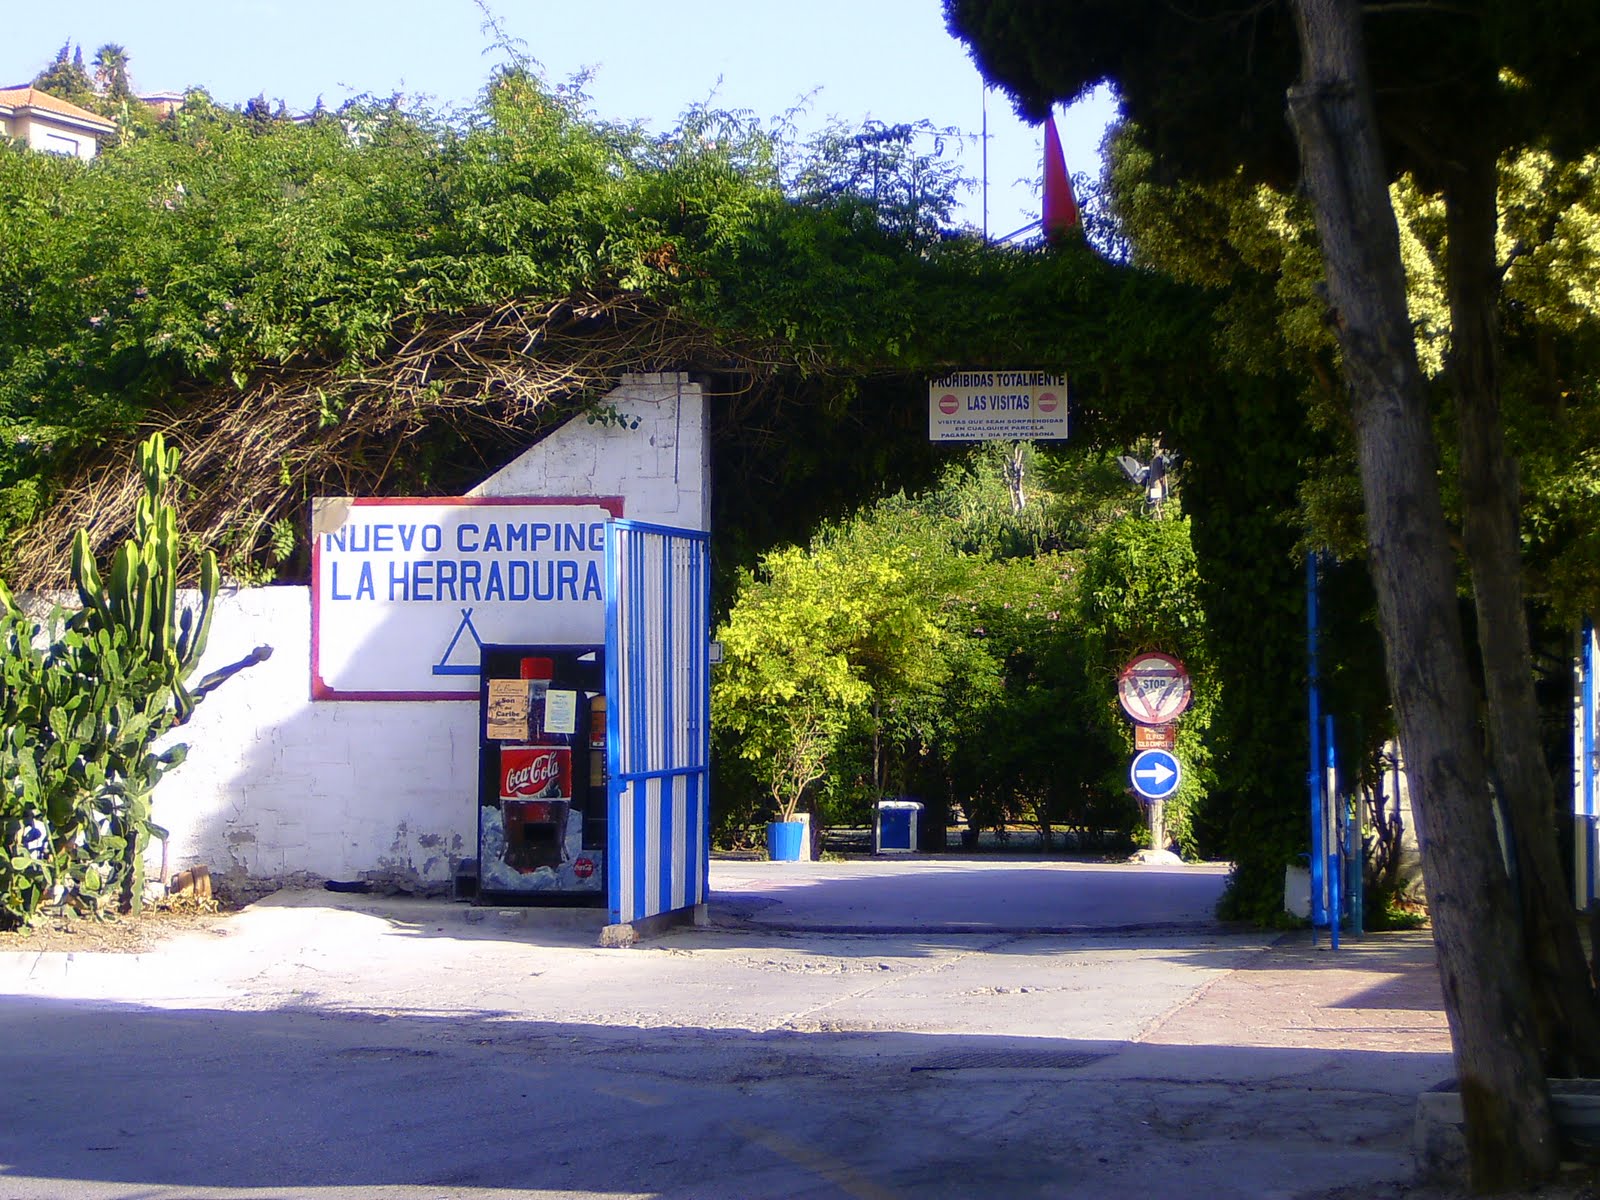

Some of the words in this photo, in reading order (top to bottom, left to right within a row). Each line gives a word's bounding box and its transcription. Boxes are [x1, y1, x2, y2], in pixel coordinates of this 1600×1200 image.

[931, 373, 994, 388] PROHIBIDAS
[997, 372, 1065, 387] TOTALMENTE
[967, 395, 987, 411] LAS
[989, 394, 1030, 410] VISITAS
[326, 523, 442, 552] NUEVO
[456, 523, 605, 552] CAMPING
[331, 560, 375, 600] LA
[389, 560, 603, 601] HERRADURA
[1143, 679, 1166, 690] STOP
[506, 751, 560, 794] Coca-Cola
